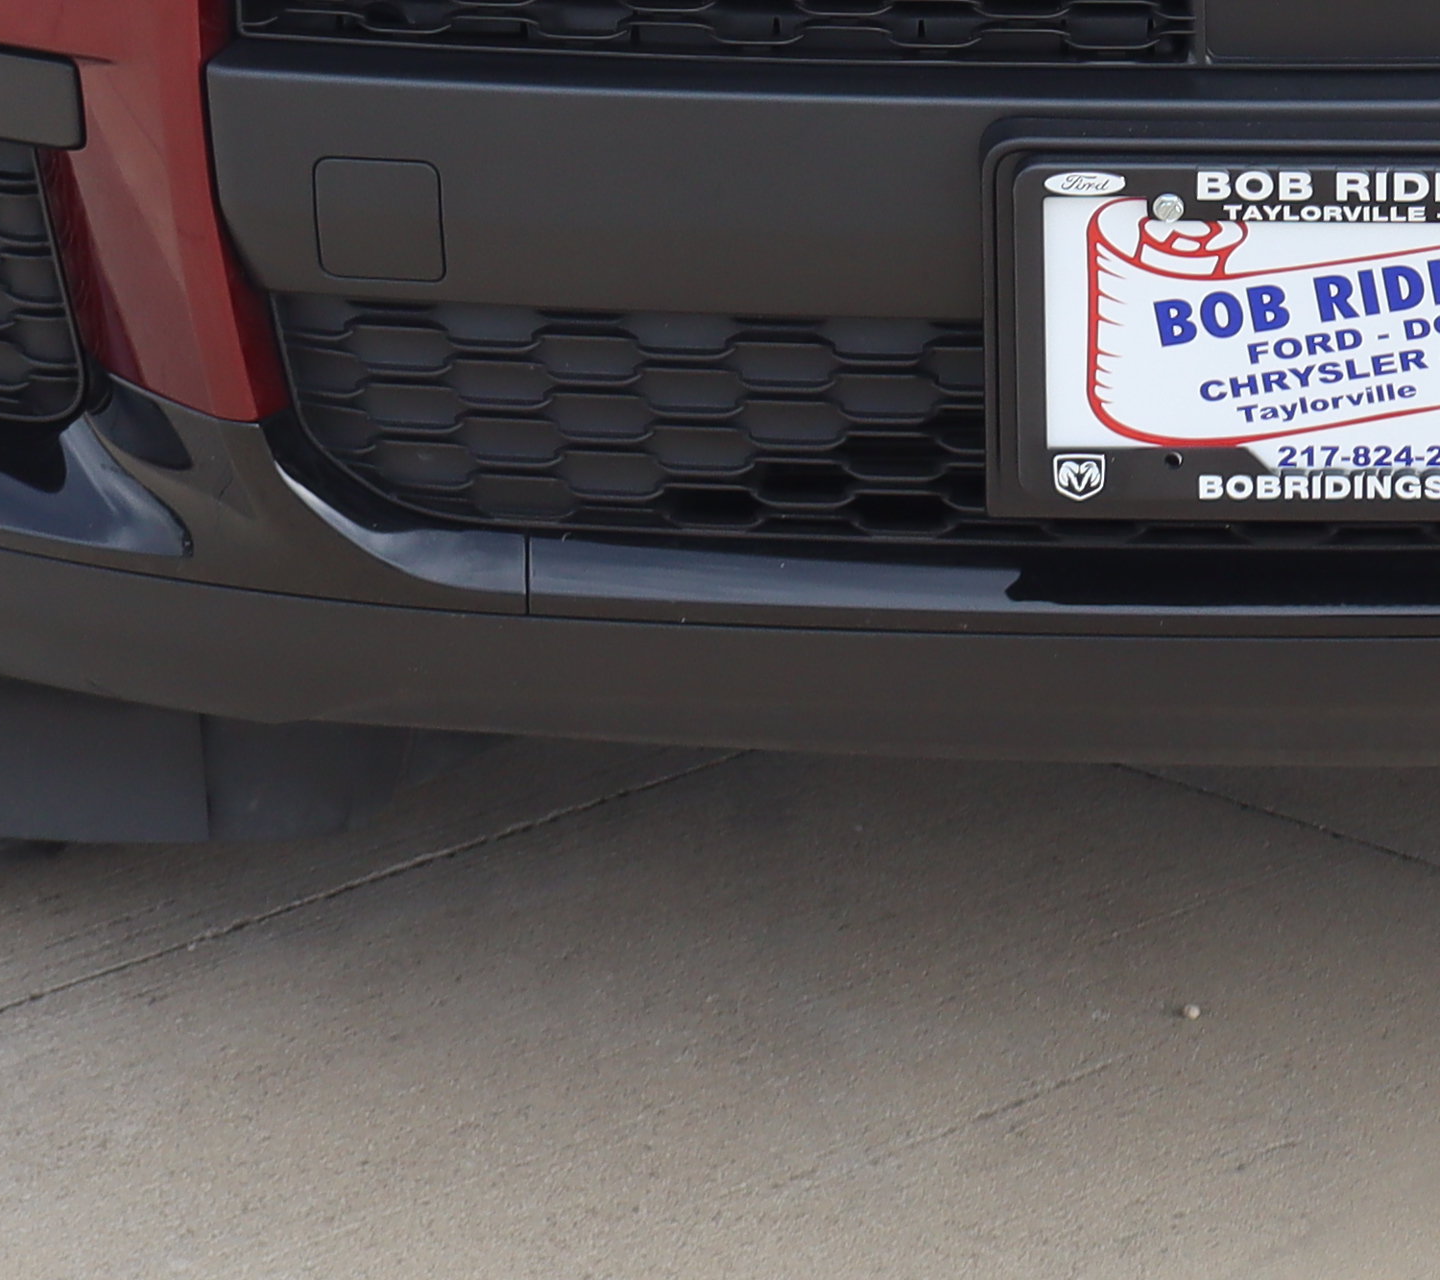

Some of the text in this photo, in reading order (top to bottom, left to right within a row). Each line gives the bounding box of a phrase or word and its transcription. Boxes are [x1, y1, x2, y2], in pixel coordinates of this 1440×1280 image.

[1061, 175, 1110, 190] Ford
[1196, 171, 1313, 201] BOB
[1223, 205, 1426, 222] TAYLORVILLE
[1153, 285, 1290, 347] BOB
[1247, 328, 1363, 365] FORD
[1199, 349, 1429, 402] CHRYSLER
[1236, 382, 1417, 423] Taylorville
